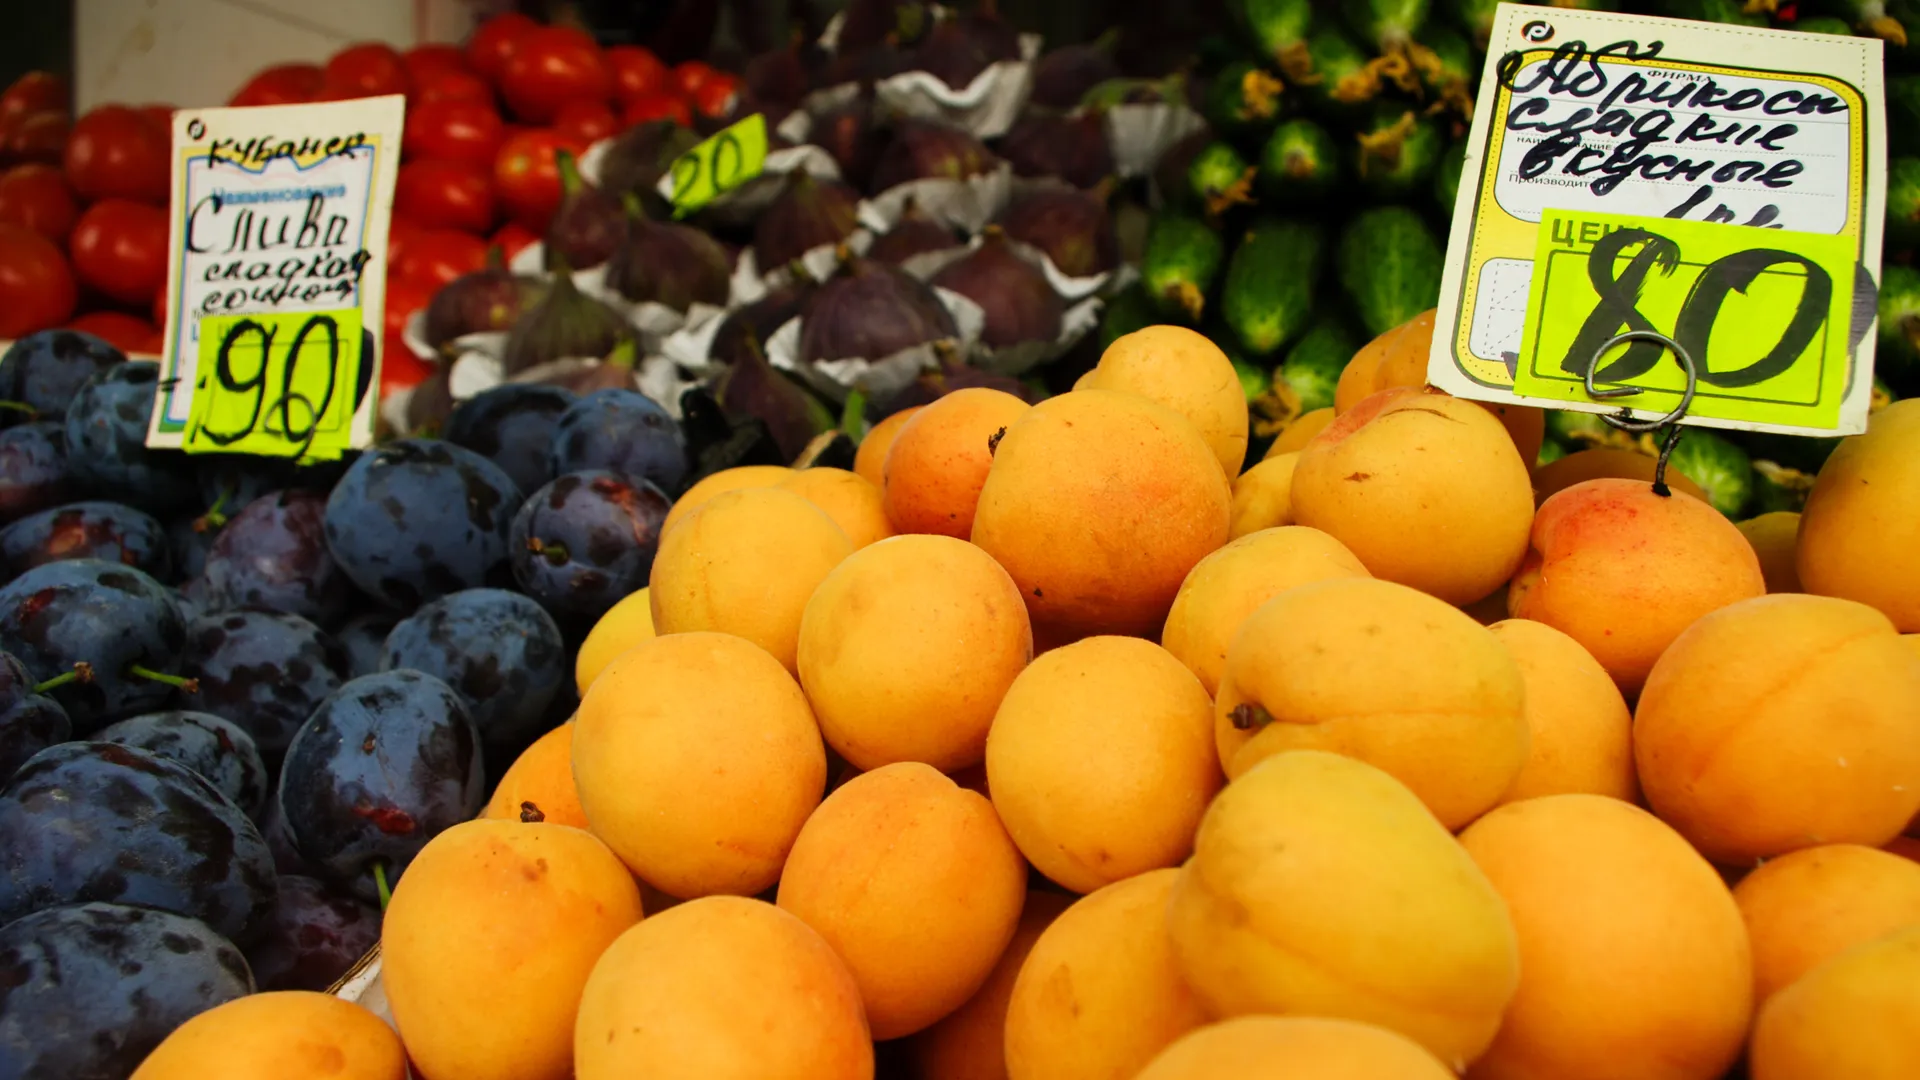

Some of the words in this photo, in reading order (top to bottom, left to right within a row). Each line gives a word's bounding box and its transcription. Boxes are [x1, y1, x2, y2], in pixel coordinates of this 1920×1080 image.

[1647, 70, 1712, 82] ФИРМА
[1560, 228, 1833, 388] 80
[201, 314, 339, 446] 90
